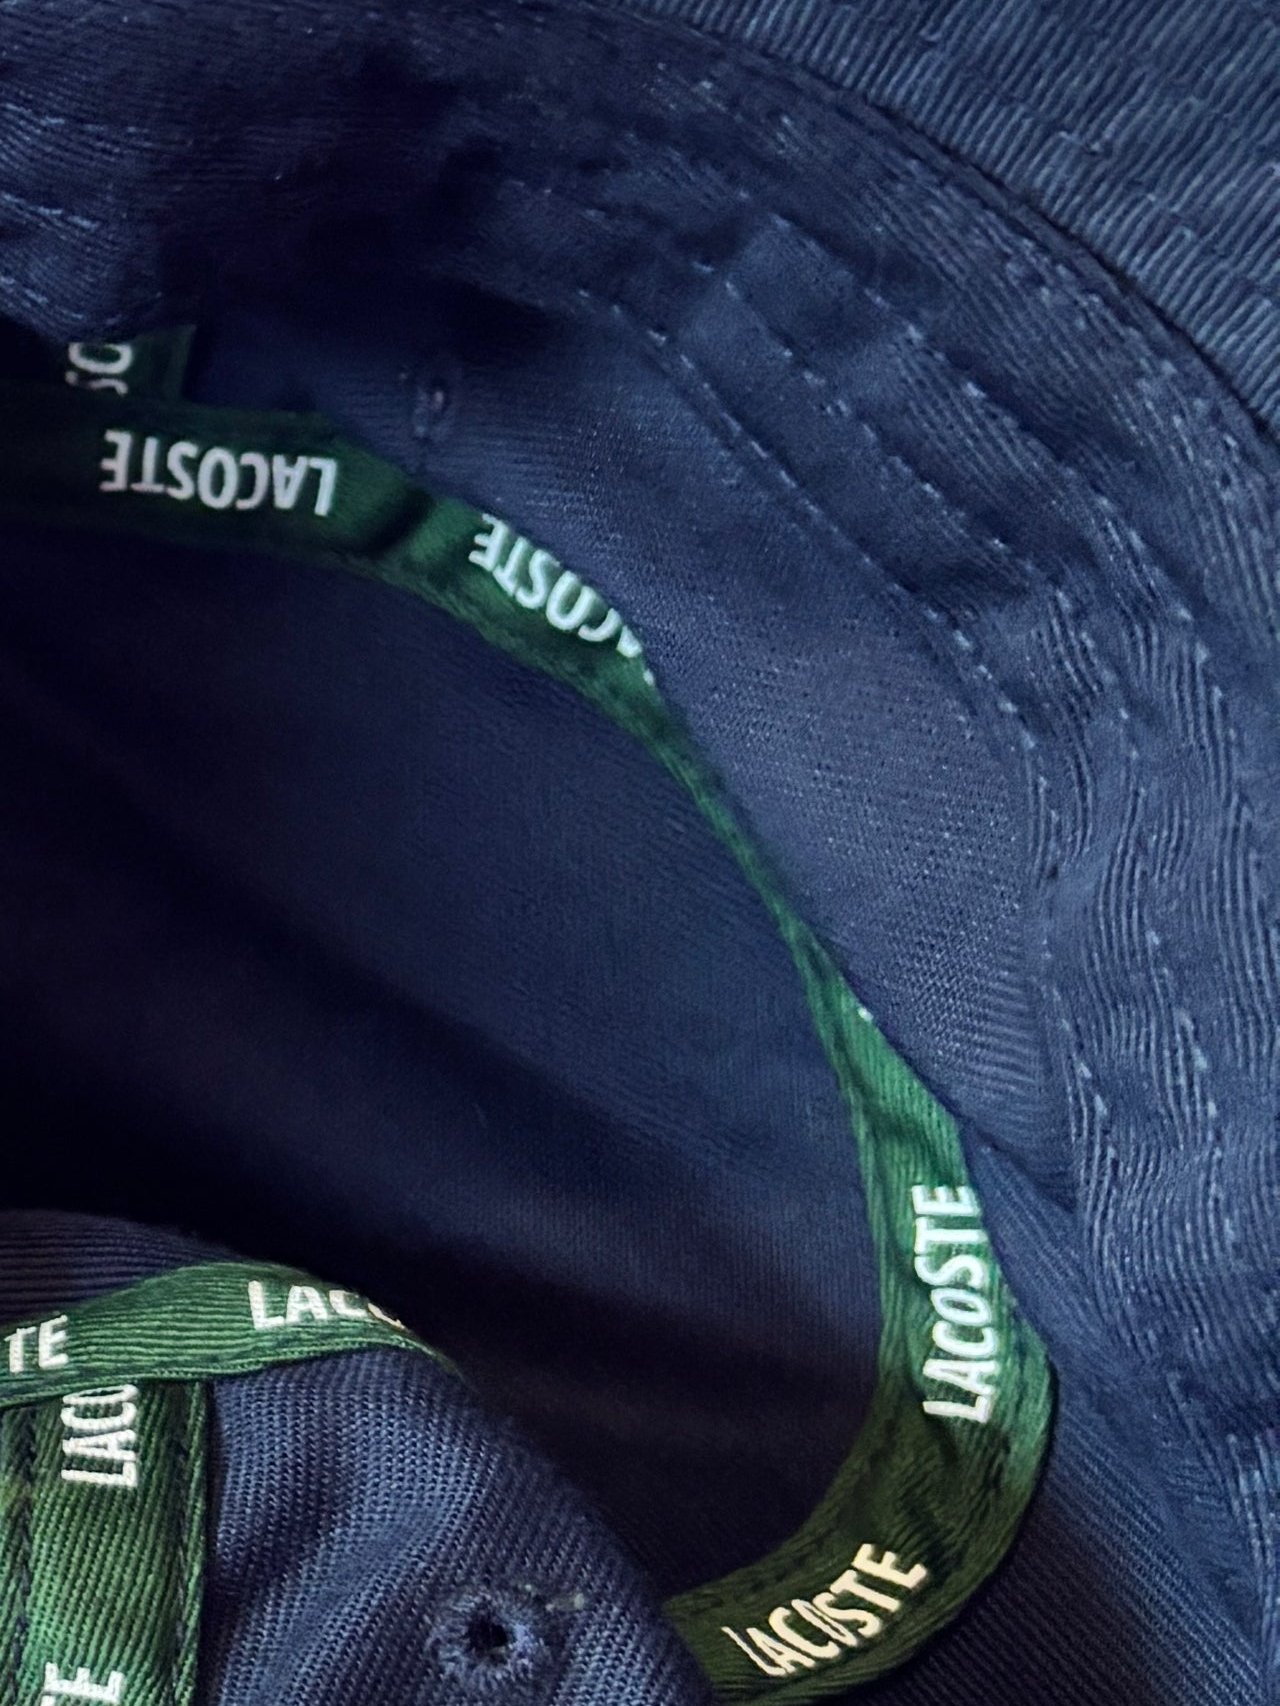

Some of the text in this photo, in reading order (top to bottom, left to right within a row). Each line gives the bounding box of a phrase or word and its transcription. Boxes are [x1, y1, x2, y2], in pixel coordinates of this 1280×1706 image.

[102, 431, 336, 515] LACOSTE
[912, 1186, 1000, 1422] LACOSTE
[722, 1544, 926, 1675] LACOSTE
